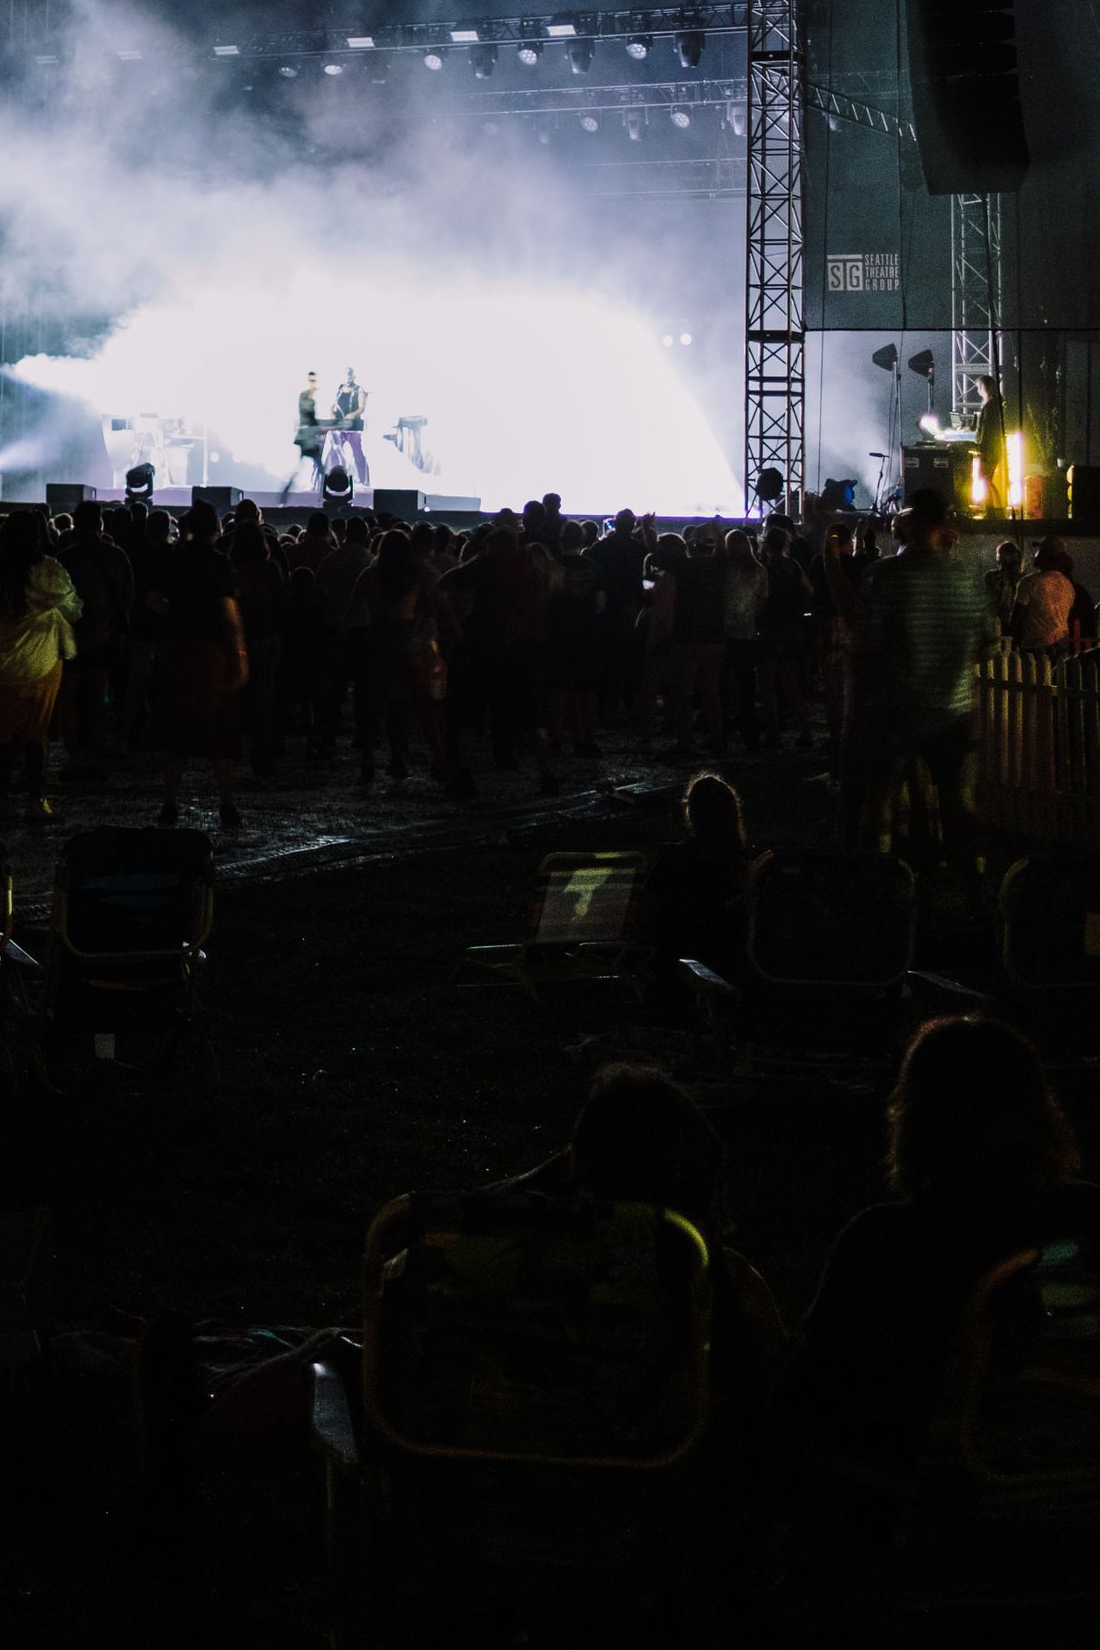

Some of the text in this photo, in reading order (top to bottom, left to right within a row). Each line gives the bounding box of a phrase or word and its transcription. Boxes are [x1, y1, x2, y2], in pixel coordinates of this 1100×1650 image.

[864, 253, 900, 266] SEATTLE
[865, 266, 900, 279] THEATRE
[865, 278, 901, 291] GROUP
